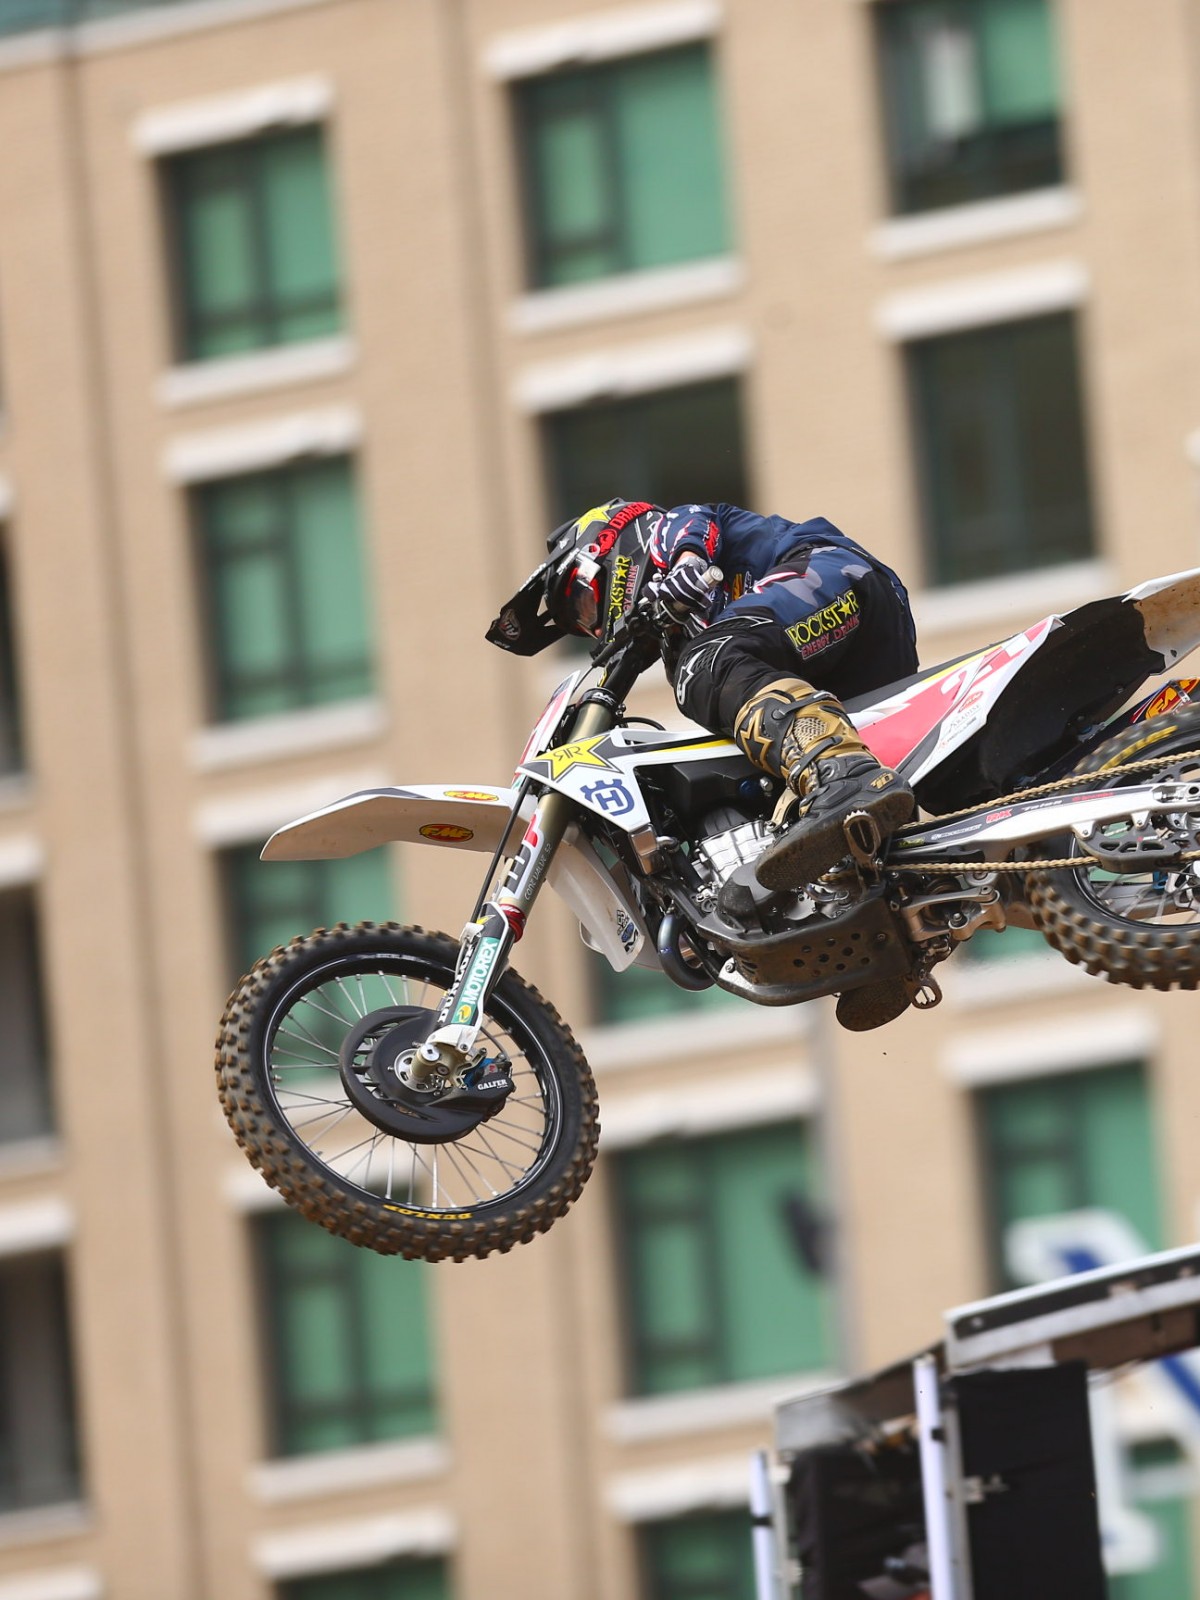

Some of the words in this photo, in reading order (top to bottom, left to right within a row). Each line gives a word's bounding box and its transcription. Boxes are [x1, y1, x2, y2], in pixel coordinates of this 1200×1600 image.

[609, 501, 654, 530] DRAGON
[801, 634, 830, 658] ENERGY
[833, 615, 860, 640] DRINK
[420, 825, 473, 840] FMF
[461, 940, 498, 1005] MOTOREX
[477, 1078, 508, 1090] GALFER
